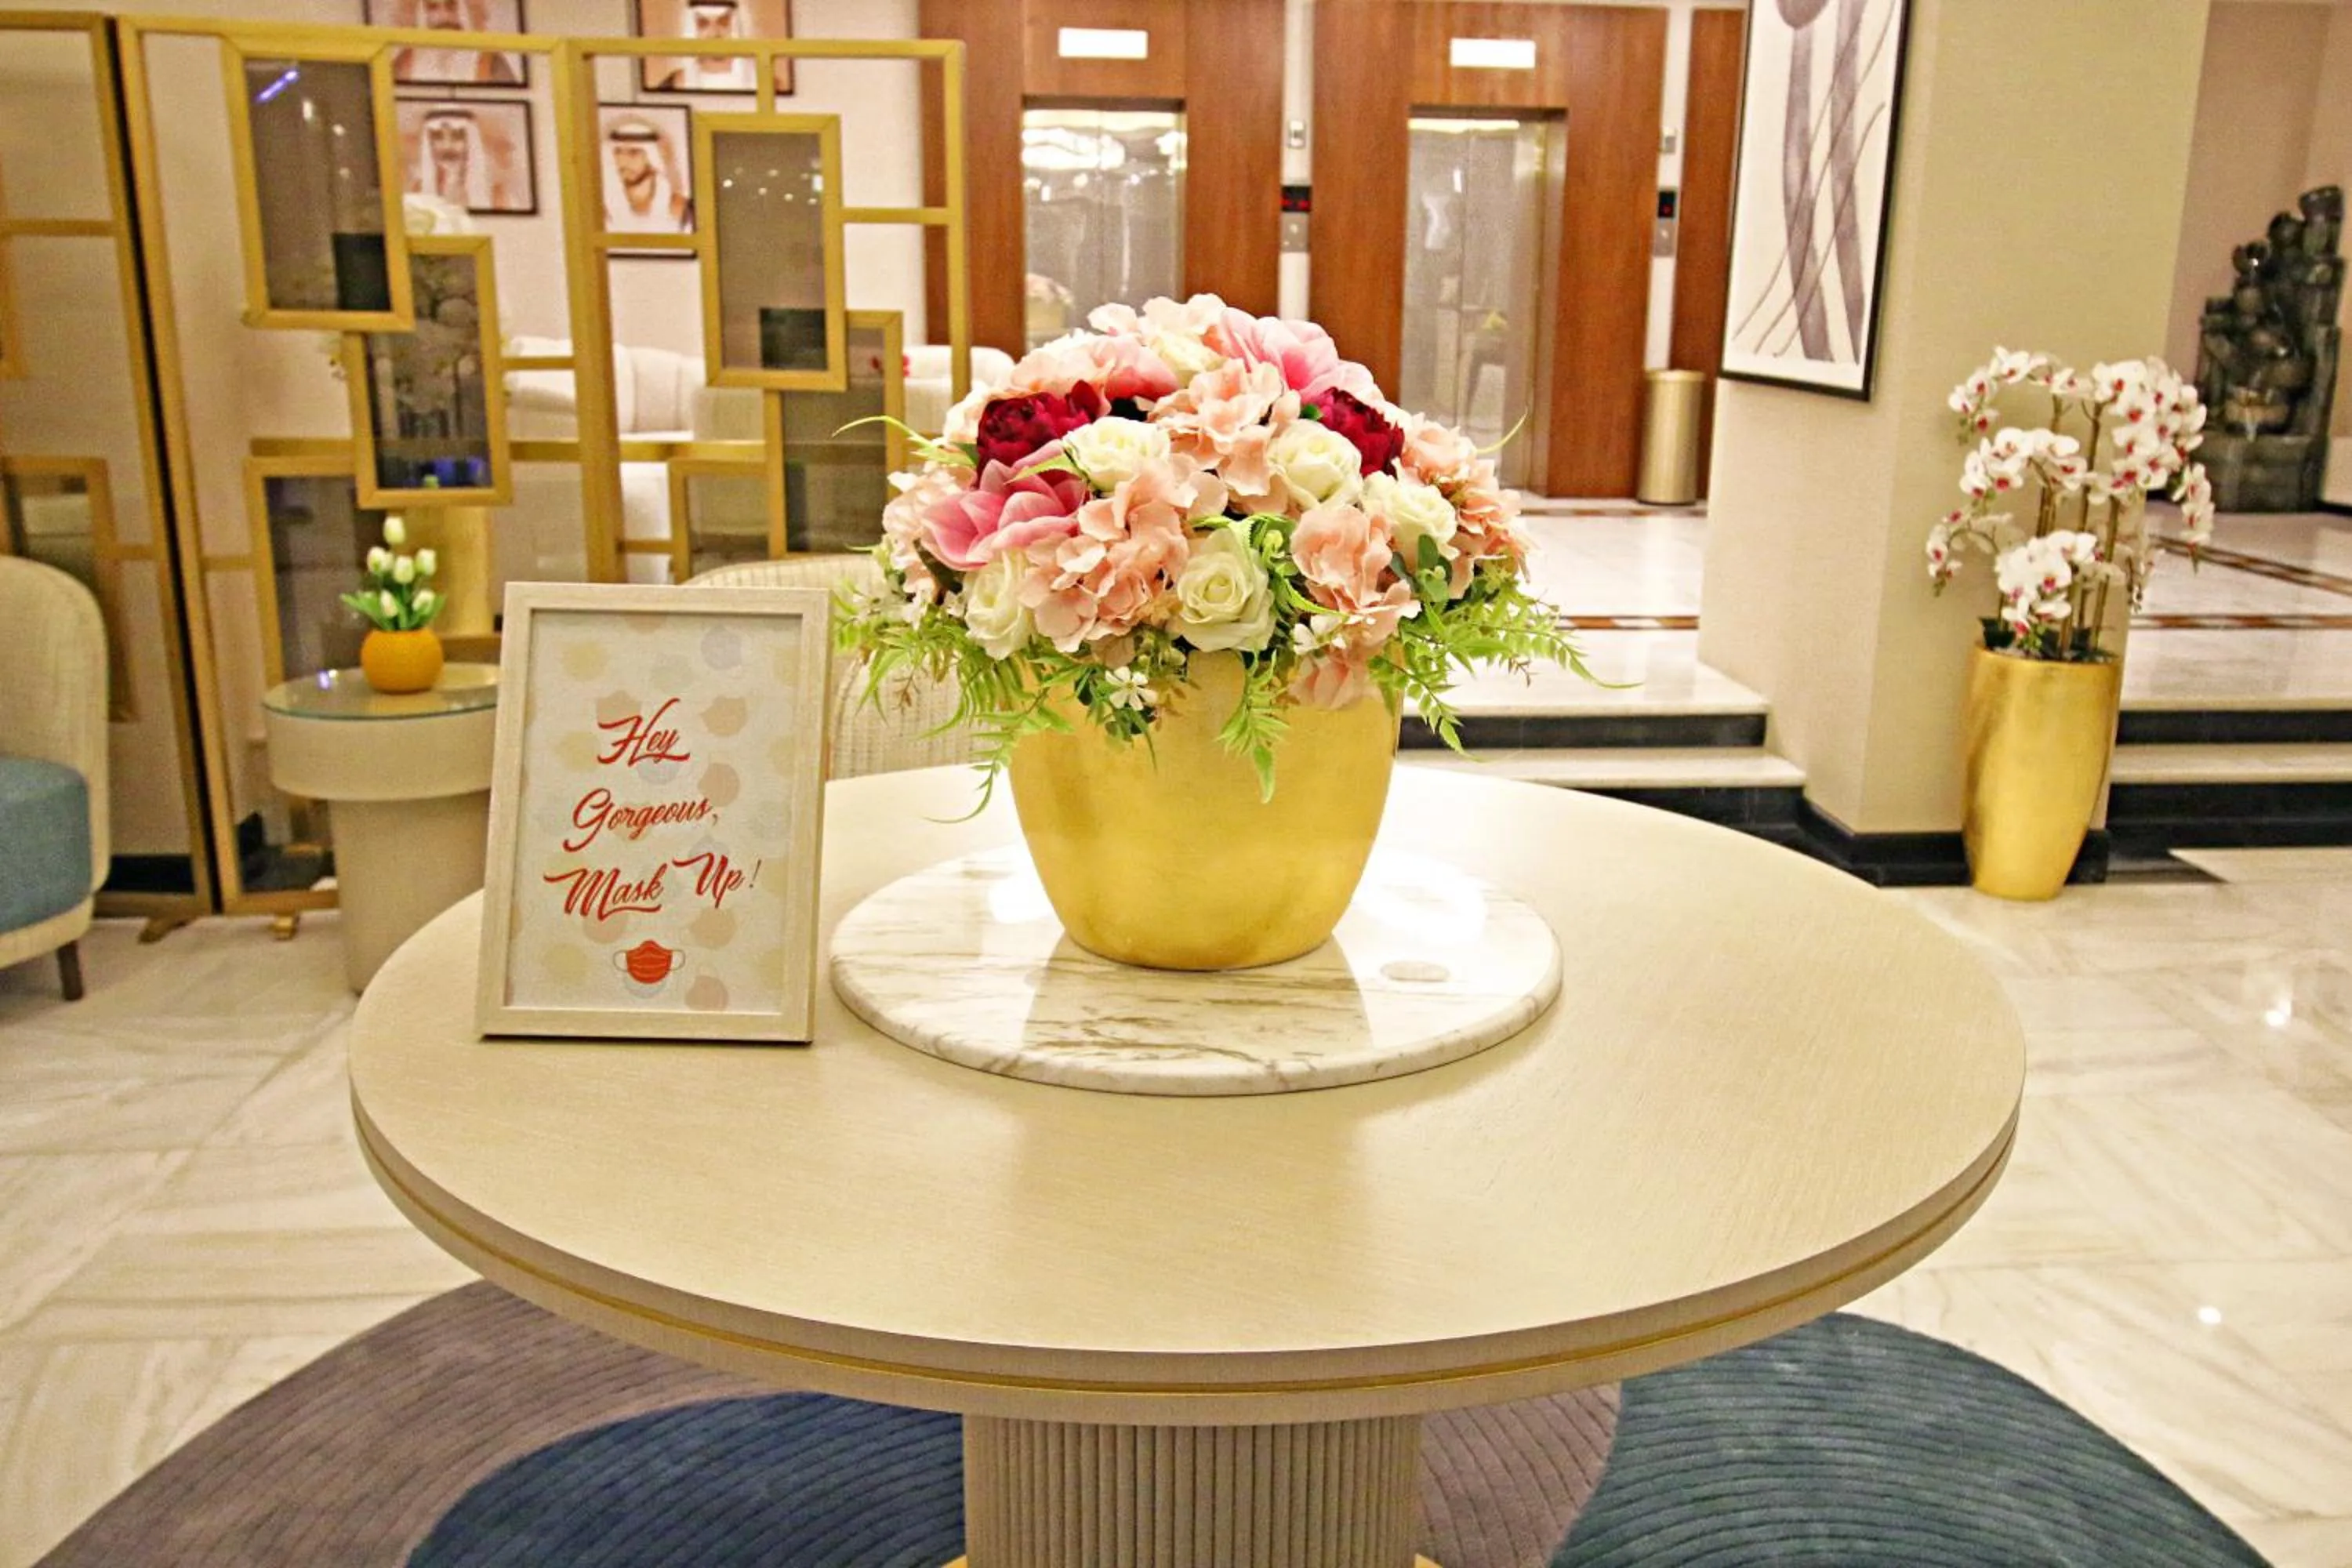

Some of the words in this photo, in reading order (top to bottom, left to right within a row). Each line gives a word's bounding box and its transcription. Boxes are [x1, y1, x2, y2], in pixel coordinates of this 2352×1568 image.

[597, 697, 691, 766] Hey
[563, 787, 719, 852] Gorgeous,
[543, 862, 667, 921] Mask
[672, 851, 761, 909] Up!
